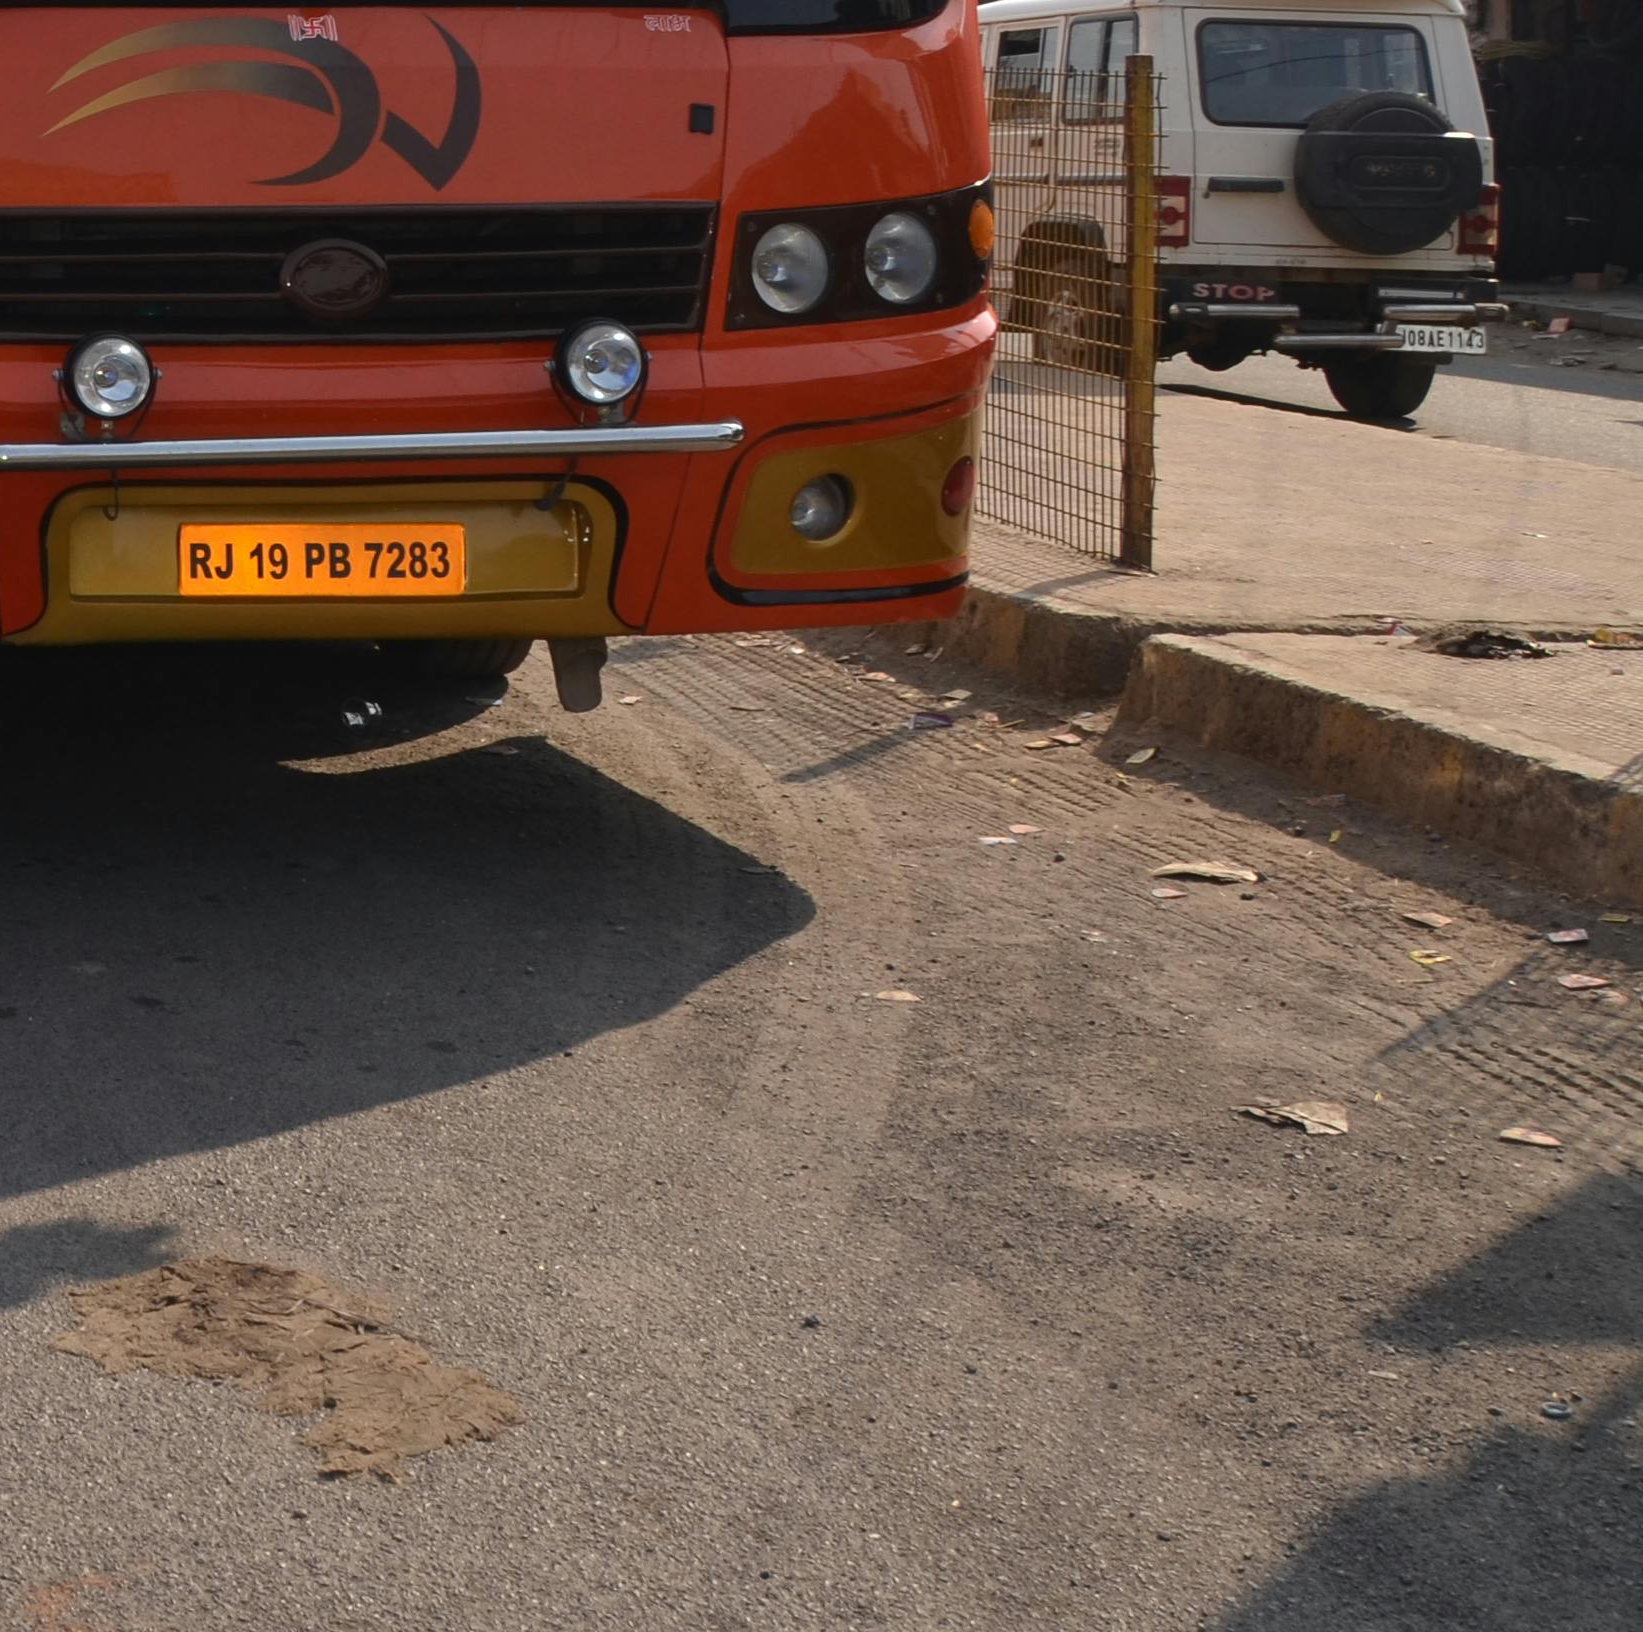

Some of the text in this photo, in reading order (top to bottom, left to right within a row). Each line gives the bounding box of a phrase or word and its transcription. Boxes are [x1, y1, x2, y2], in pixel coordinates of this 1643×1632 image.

[1192, 282, 1275, 301] STOP
[189, 541, 450, 580] RJ 19 PB 7283
